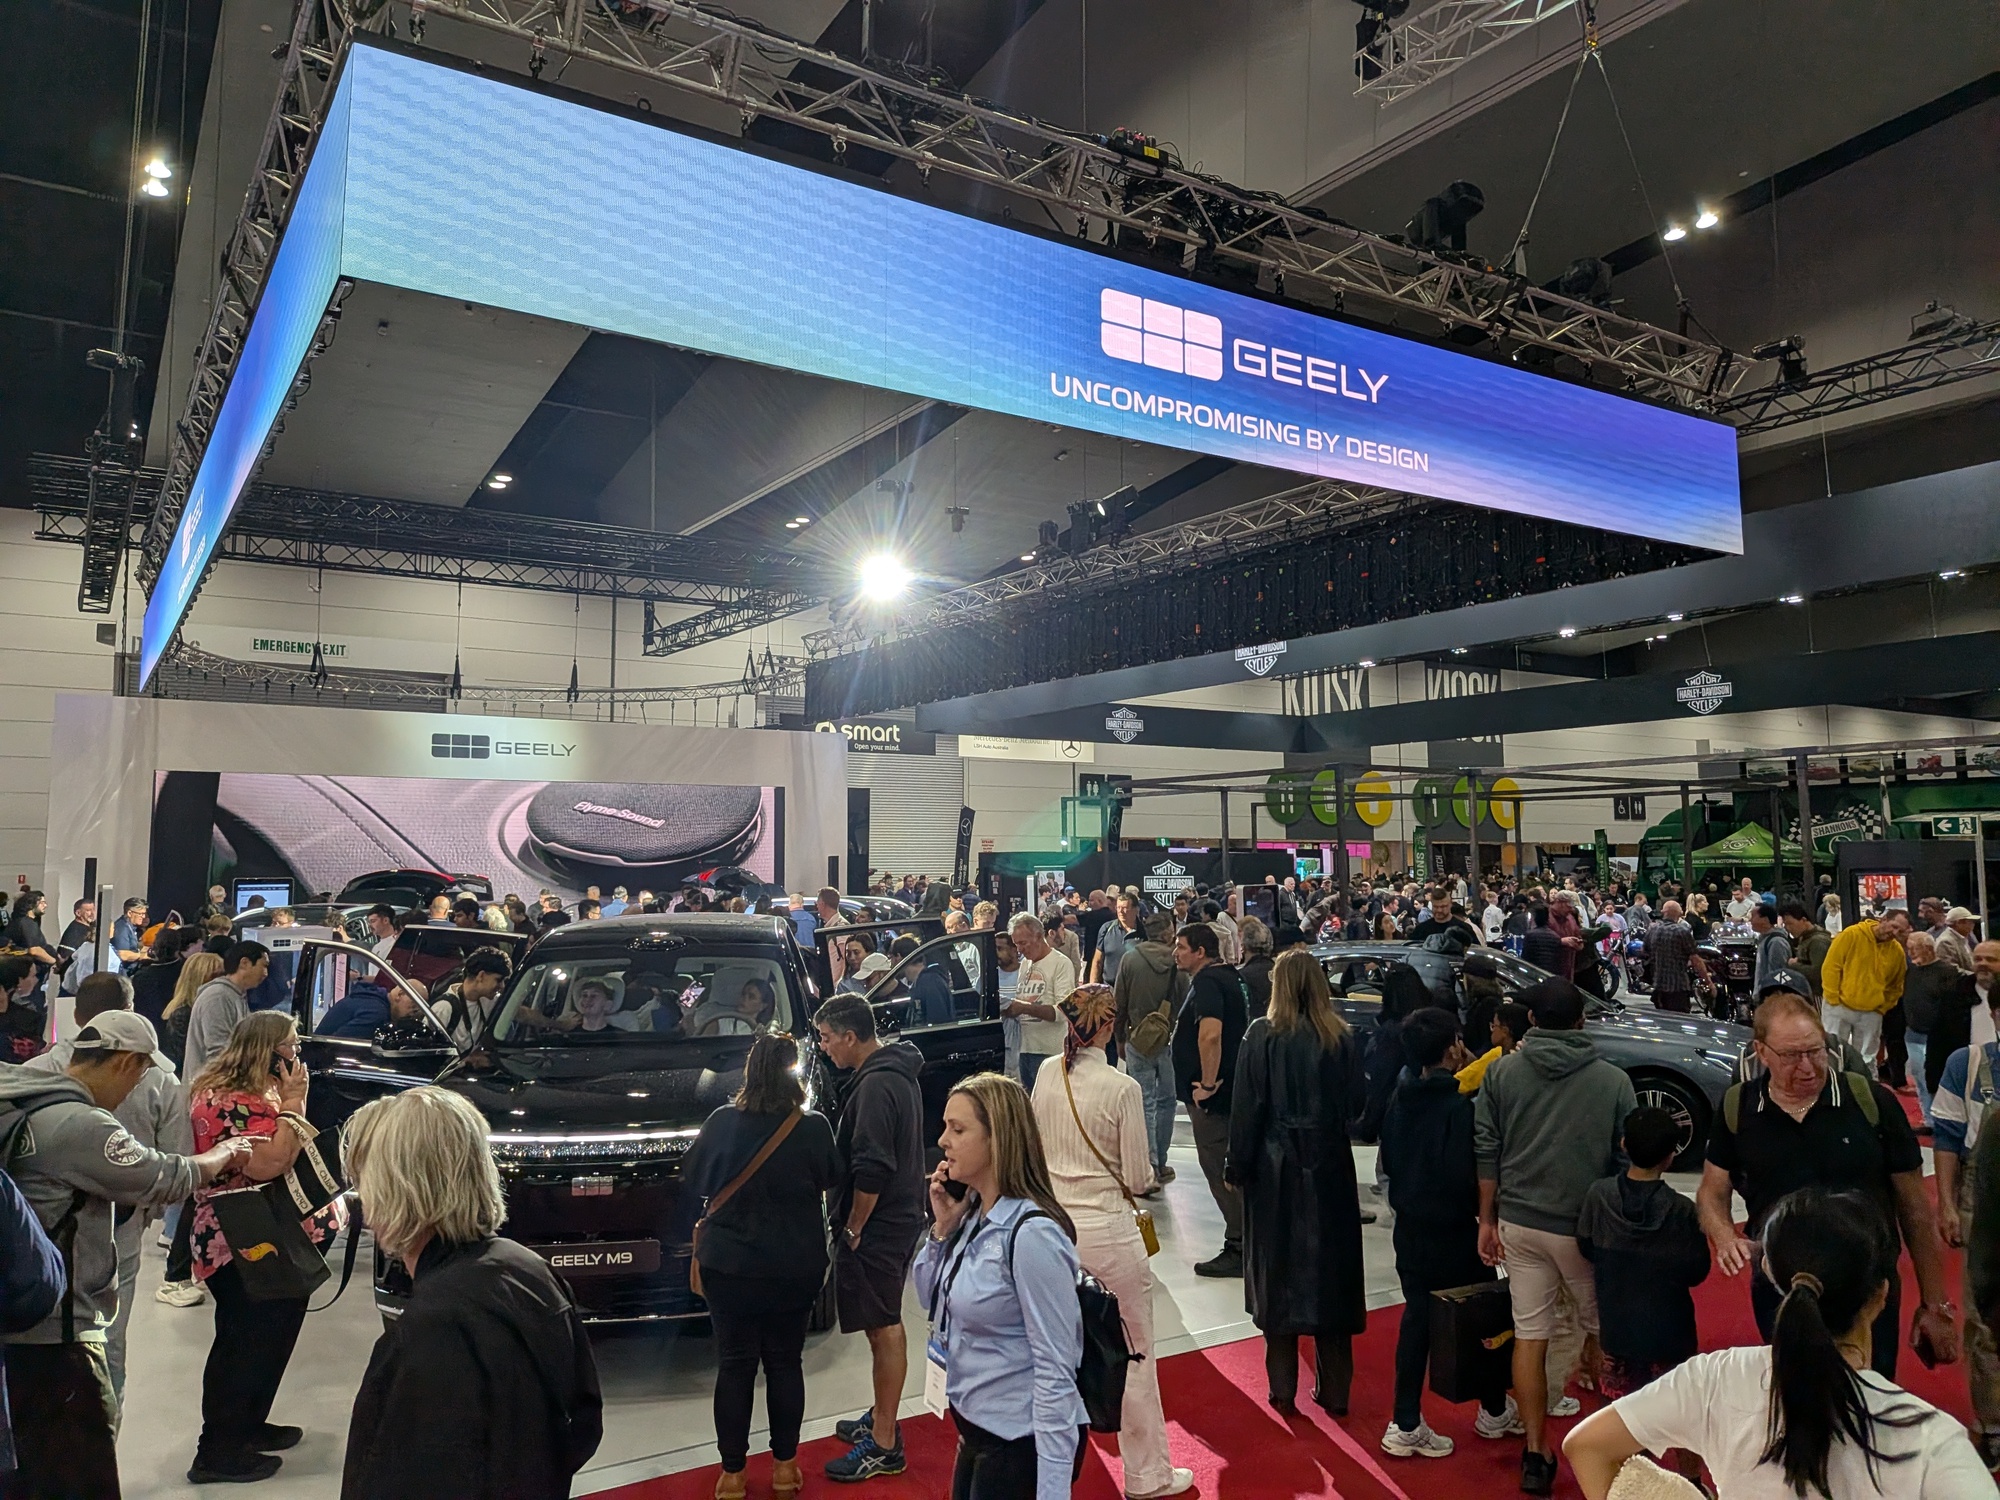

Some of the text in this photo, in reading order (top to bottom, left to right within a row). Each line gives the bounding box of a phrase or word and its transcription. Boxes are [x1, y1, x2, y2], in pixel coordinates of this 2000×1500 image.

[1233, 338, 1389, 403] GEELY
[1050, 372, 1430, 473] UNCOMPROMISING BY DESIGN
[253, 638, 347, 656] EMERGENCY EXIT
[1248, 655, 1274, 673] CYCLES
[1689, 674, 1717, 686] MOTOR
[1679, 684, 1730, 700] HARLEY-DAVIDSON
[1691, 698, 1719, 712] CYCLES
[841, 724, 900, 743] smart
[495, 741, 577, 757] GEELY
[854, 743, 870, 751] Open
[573, 801, 666, 828] Flyme Sound
[1812, 819, 1858, 837] SHANNONS
[1157, 863, 1182, 875] MOTOR
[1145, 878, 1192, 890] HARLEY-DAVIDSON
[1017, 982, 1045, 995] Gulf
[308, 1146, 321, 1167] Chloé
[319, 1170, 335, 1190] Chloé
[551, 1251, 633, 1267] GEELY M9
